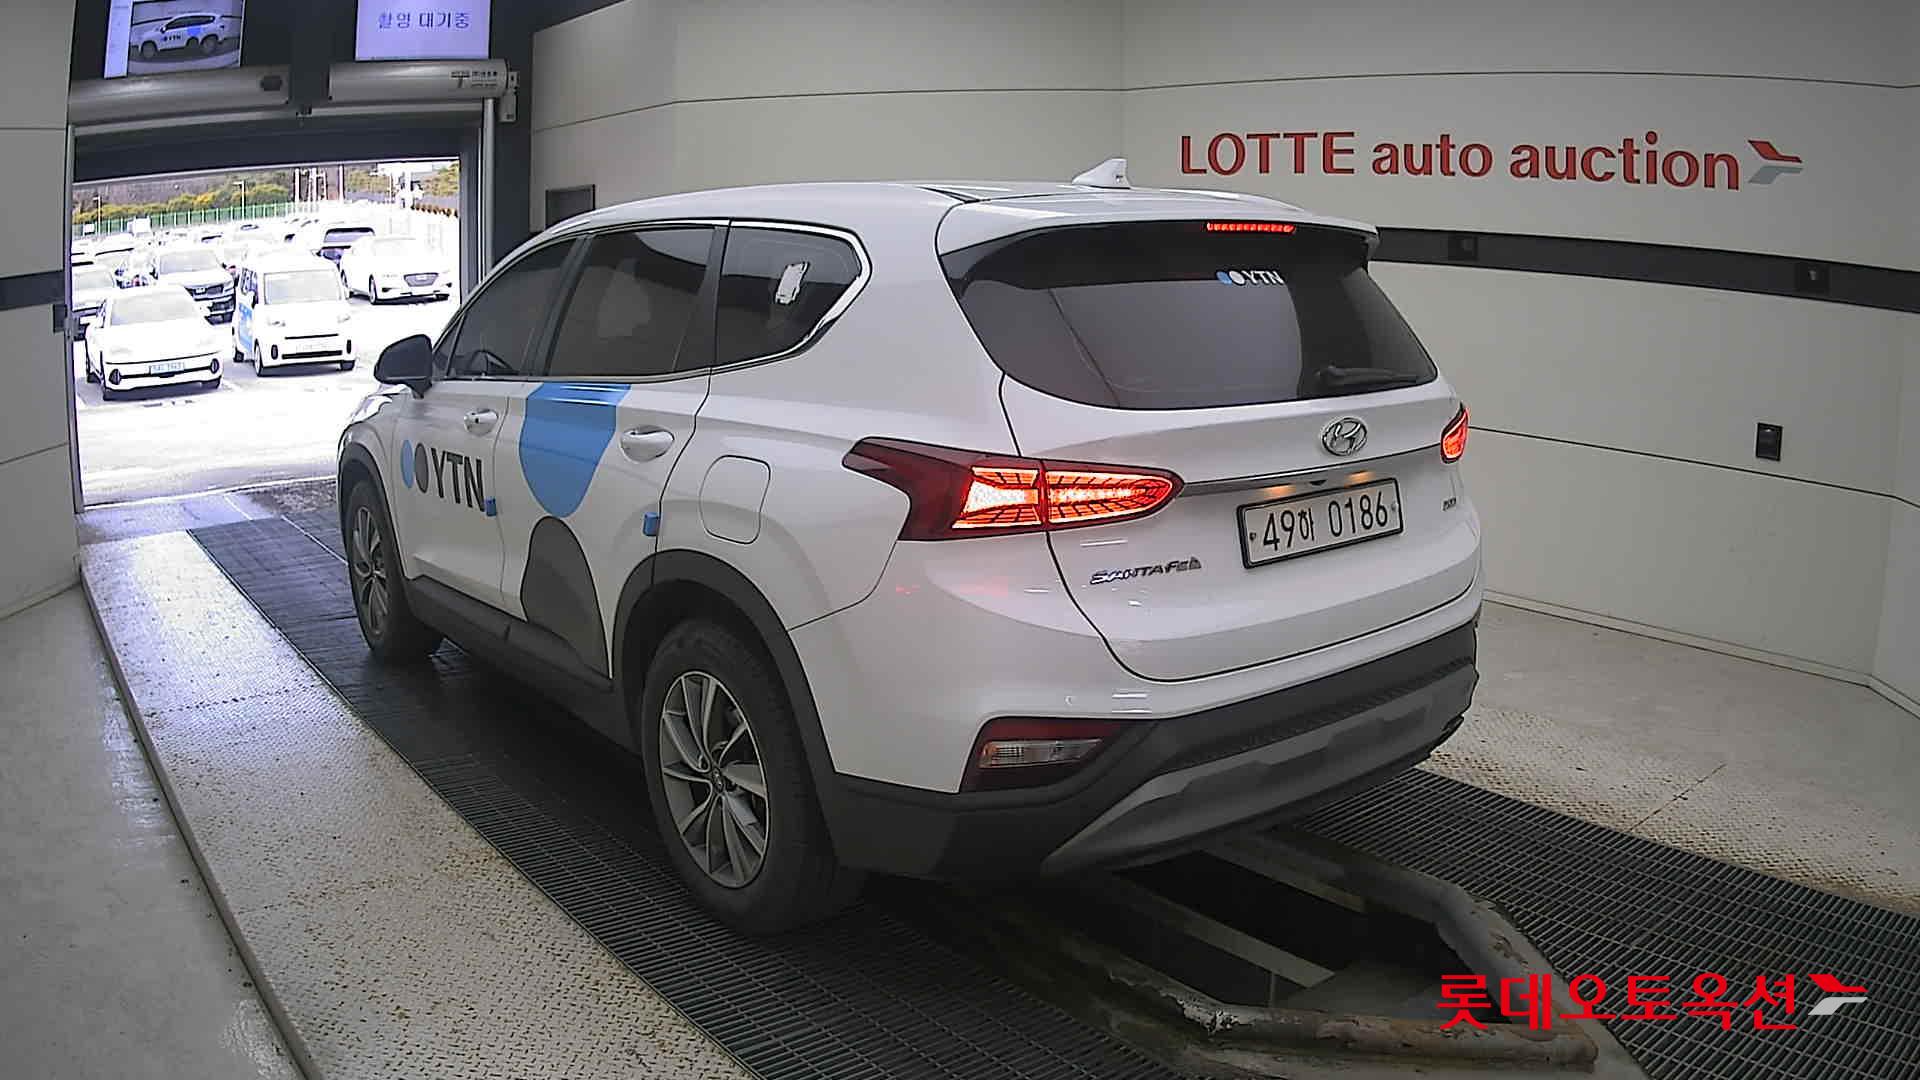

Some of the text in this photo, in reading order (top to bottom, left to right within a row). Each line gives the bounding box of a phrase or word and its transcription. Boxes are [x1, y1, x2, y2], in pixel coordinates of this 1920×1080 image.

[418, 11, 469, 29] 대기중
[1180, 130, 1740, 191] LOTTE auto auction
[1241, 270, 1284, 285] YTN
[430, 447, 486, 513] YTN
[1262, 490, 1389, 552] 49하 0186
